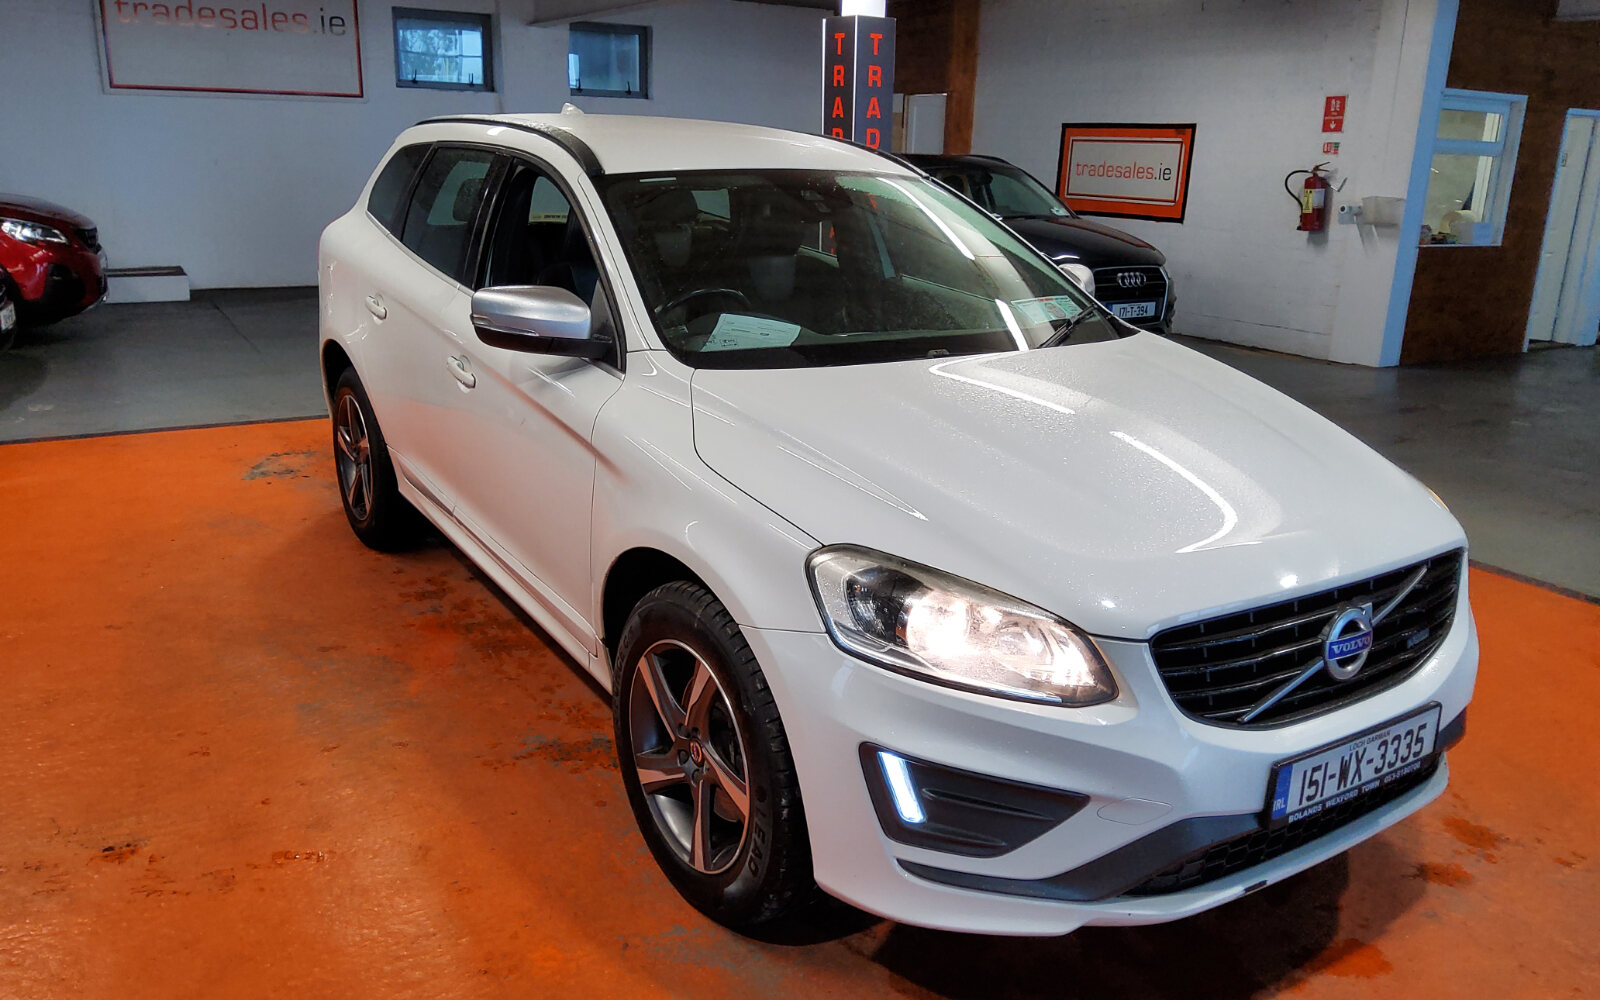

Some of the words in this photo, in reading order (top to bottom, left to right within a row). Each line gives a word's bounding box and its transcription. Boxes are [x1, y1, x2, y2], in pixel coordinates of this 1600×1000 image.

[115, 0, 347, 36] tradesales.ie
[866, 32, 883, 150] TRAD
[1075, 160, 1172, 182] tradesales.ie
[1119, 304, 1149, 318] 171-T-394
[1331, 635, 1371, 655] VOLVO
[1298, 722, 1428, 807] 151-WX-3335
[1272, 797, 1287, 812] IRL
[1288, 803, 1323, 824] BOLANDS
[1325, 789, 1359, 809] WEXFORD
[1361, 779, 1381, 793] TOWN
